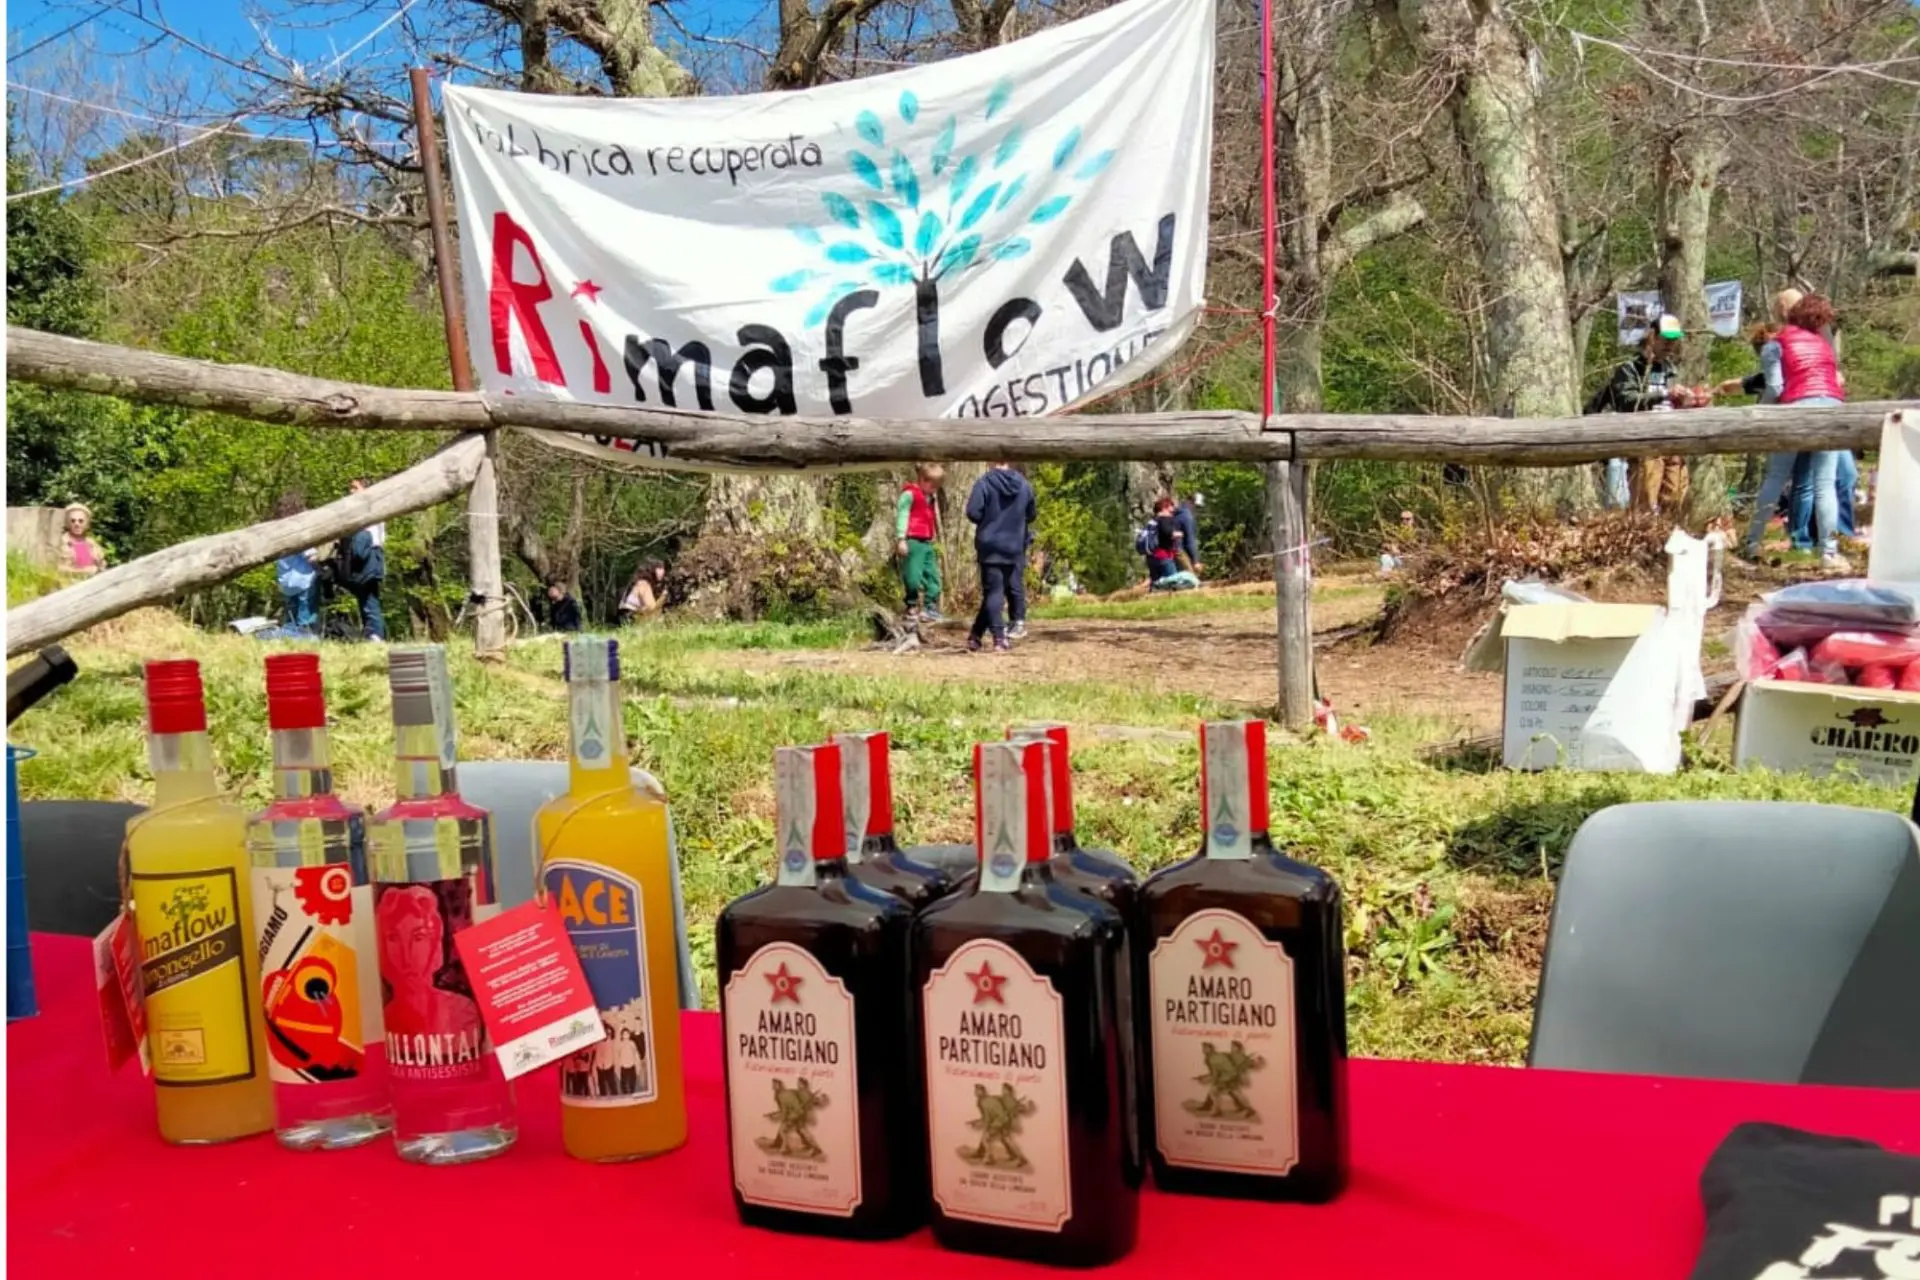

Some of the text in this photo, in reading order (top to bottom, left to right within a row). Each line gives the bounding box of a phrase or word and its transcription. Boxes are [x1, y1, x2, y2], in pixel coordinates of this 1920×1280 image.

[648, 135, 823, 187] recuperata
[489, 211, 1178, 415] Rimaflow
[1810, 725, 1920, 755] CHARRO
[560, 872, 630, 927] ACE
[1187, 973, 1252, 1001] AMARO
[757, 1008, 817, 1037] AMARO
[959, 1009, 1022, 1040] AMARO
[1165, 997, 1277, 1029] PARTIGIANO
[739, 1032, 839, 1065] PARTIGIANO
[939, 1034, 1047, 1070] PARTIGIANO
